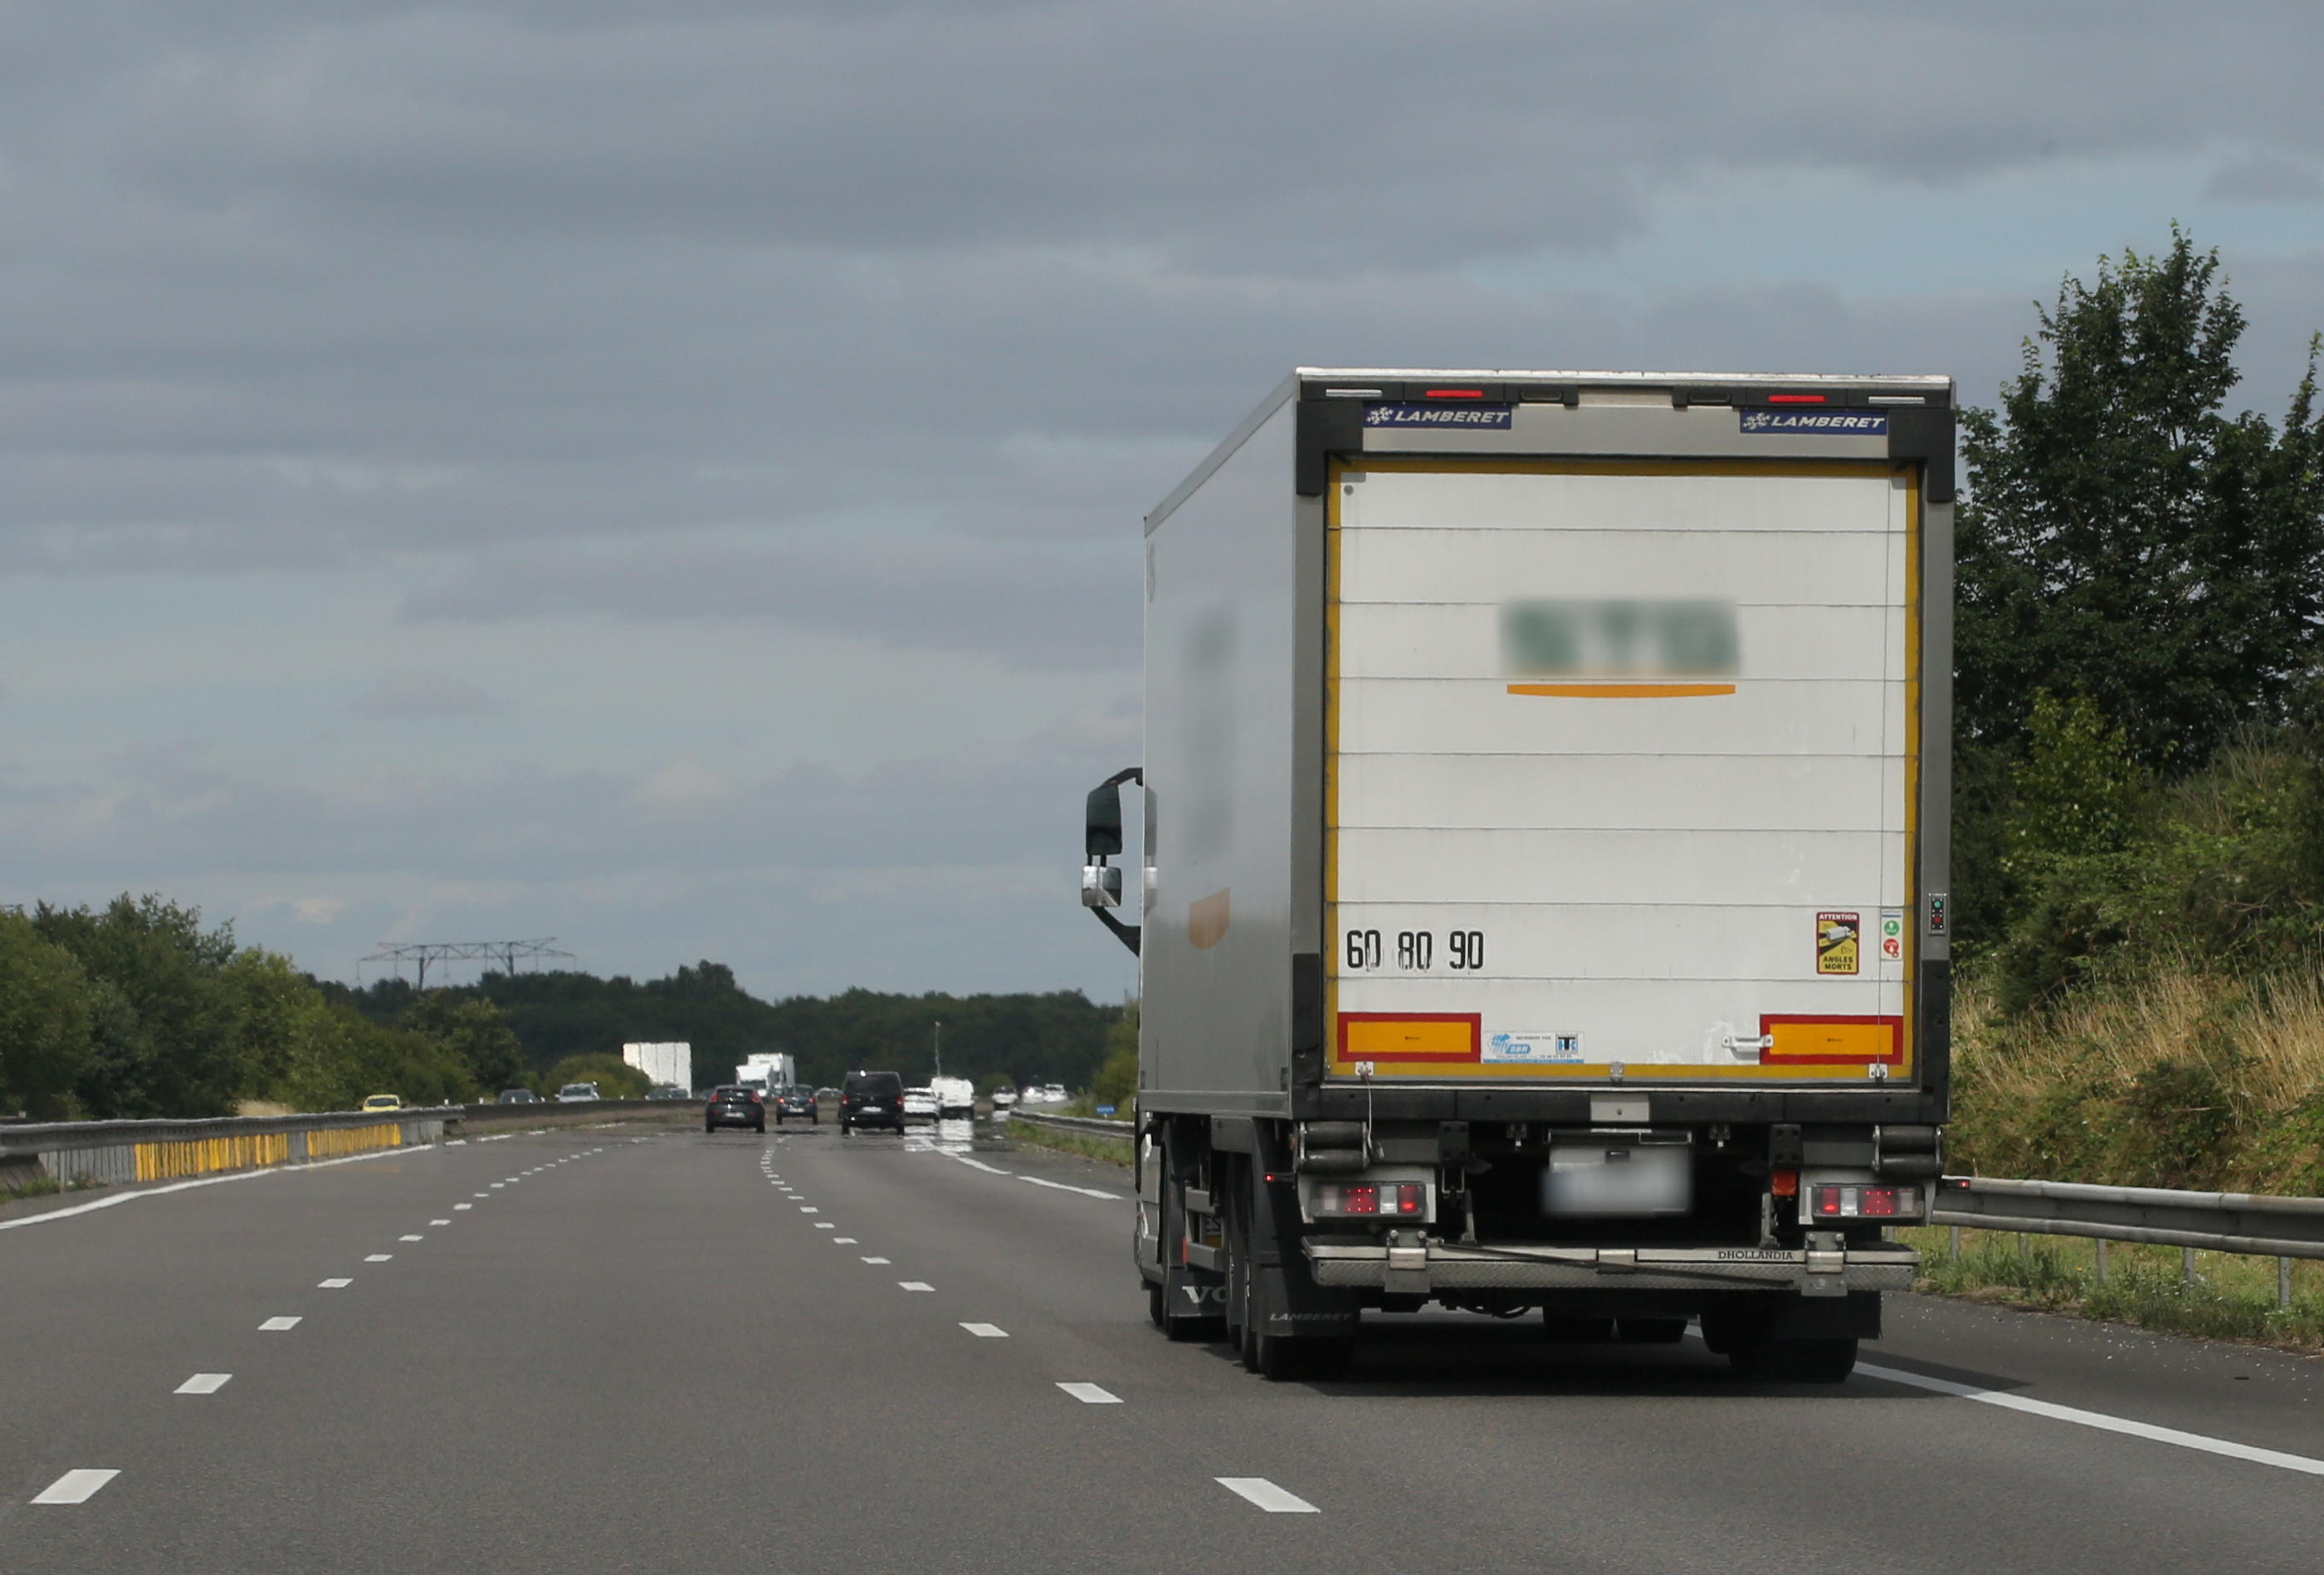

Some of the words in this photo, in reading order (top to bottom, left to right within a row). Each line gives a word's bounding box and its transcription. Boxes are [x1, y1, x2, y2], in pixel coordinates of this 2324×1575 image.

[1394, 410, 1510, 426] LAMBERET
[1770, 413, 1886, 430] LAMBERET
[1346, 930, 1381, 971] 60
[1398, 931, 1433, 971] 80
[1448, 930, 1484, 970] 90
[1718, 1250, 1794, 1260] DHOLLANDIA
[1269, 1313, 1353, 1322] LAMBERET
